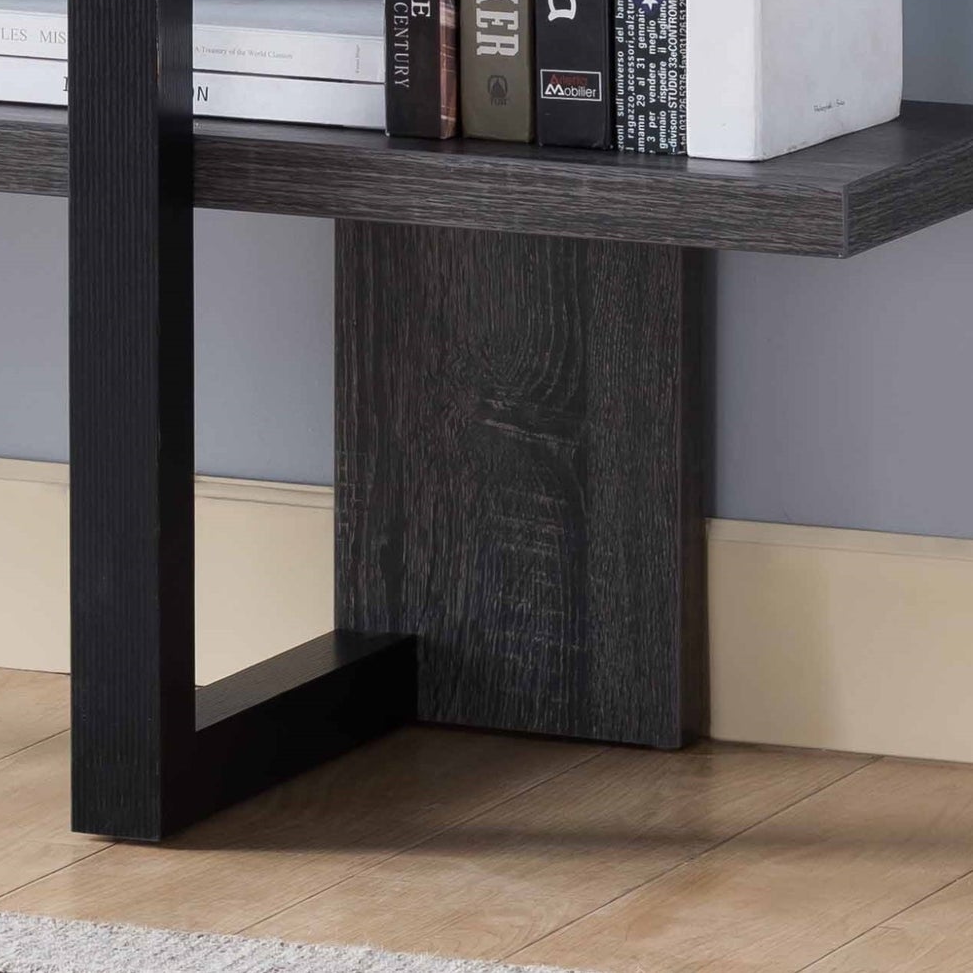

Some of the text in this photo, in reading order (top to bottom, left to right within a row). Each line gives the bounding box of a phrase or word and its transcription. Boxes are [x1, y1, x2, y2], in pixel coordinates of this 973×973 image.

[1, 27, 27, 42] LES
[615, 27, 624, 43] del
[647, 19, 657, 55] meglio
[393, 2, 410, 88] CENTURY
[636, 57, 645, 69] 31
[544, 83, 597, 98] Mobilier
[636, 77, 645, 87] al
[647, 62, 656, 104] vendere
[658, 60, 668, 104] rispedire
[668, 70, 678, 109] STUDIO
[636, 94, 645, 107] 29
[648, 111, 657, 129] per
[658, 110, 668, 149] gennaio
